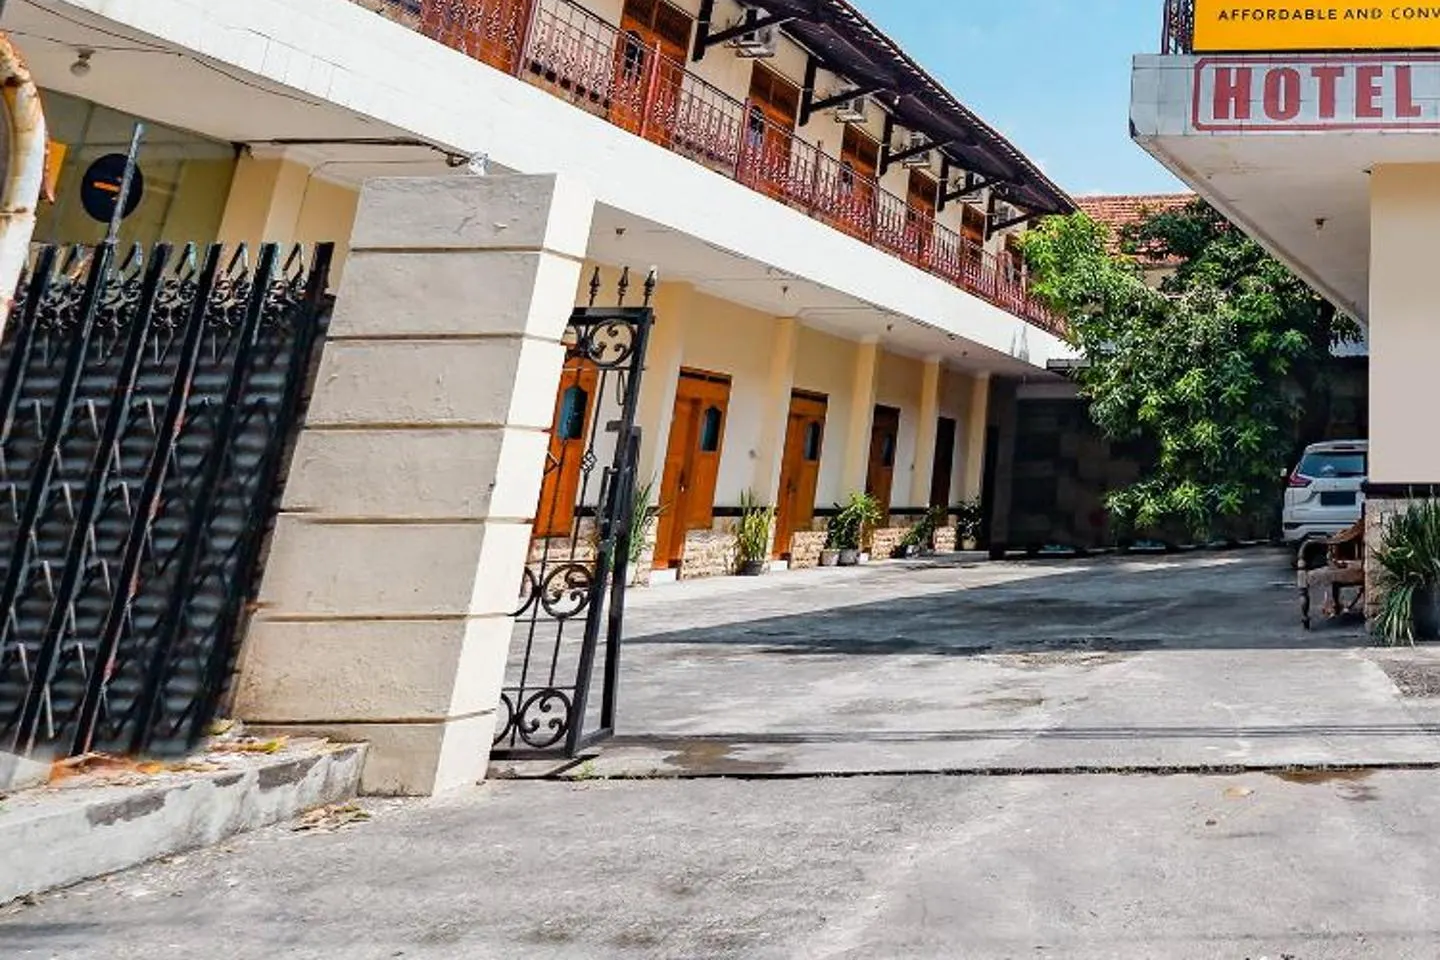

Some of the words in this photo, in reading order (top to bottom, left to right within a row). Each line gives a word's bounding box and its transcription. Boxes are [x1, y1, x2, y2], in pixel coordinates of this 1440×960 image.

[1217, 8, 1338, 22] AFFORDABLE
[1343, 7, 1383, 20] AND
[1212, 65, 1422, 121] HOTEL
